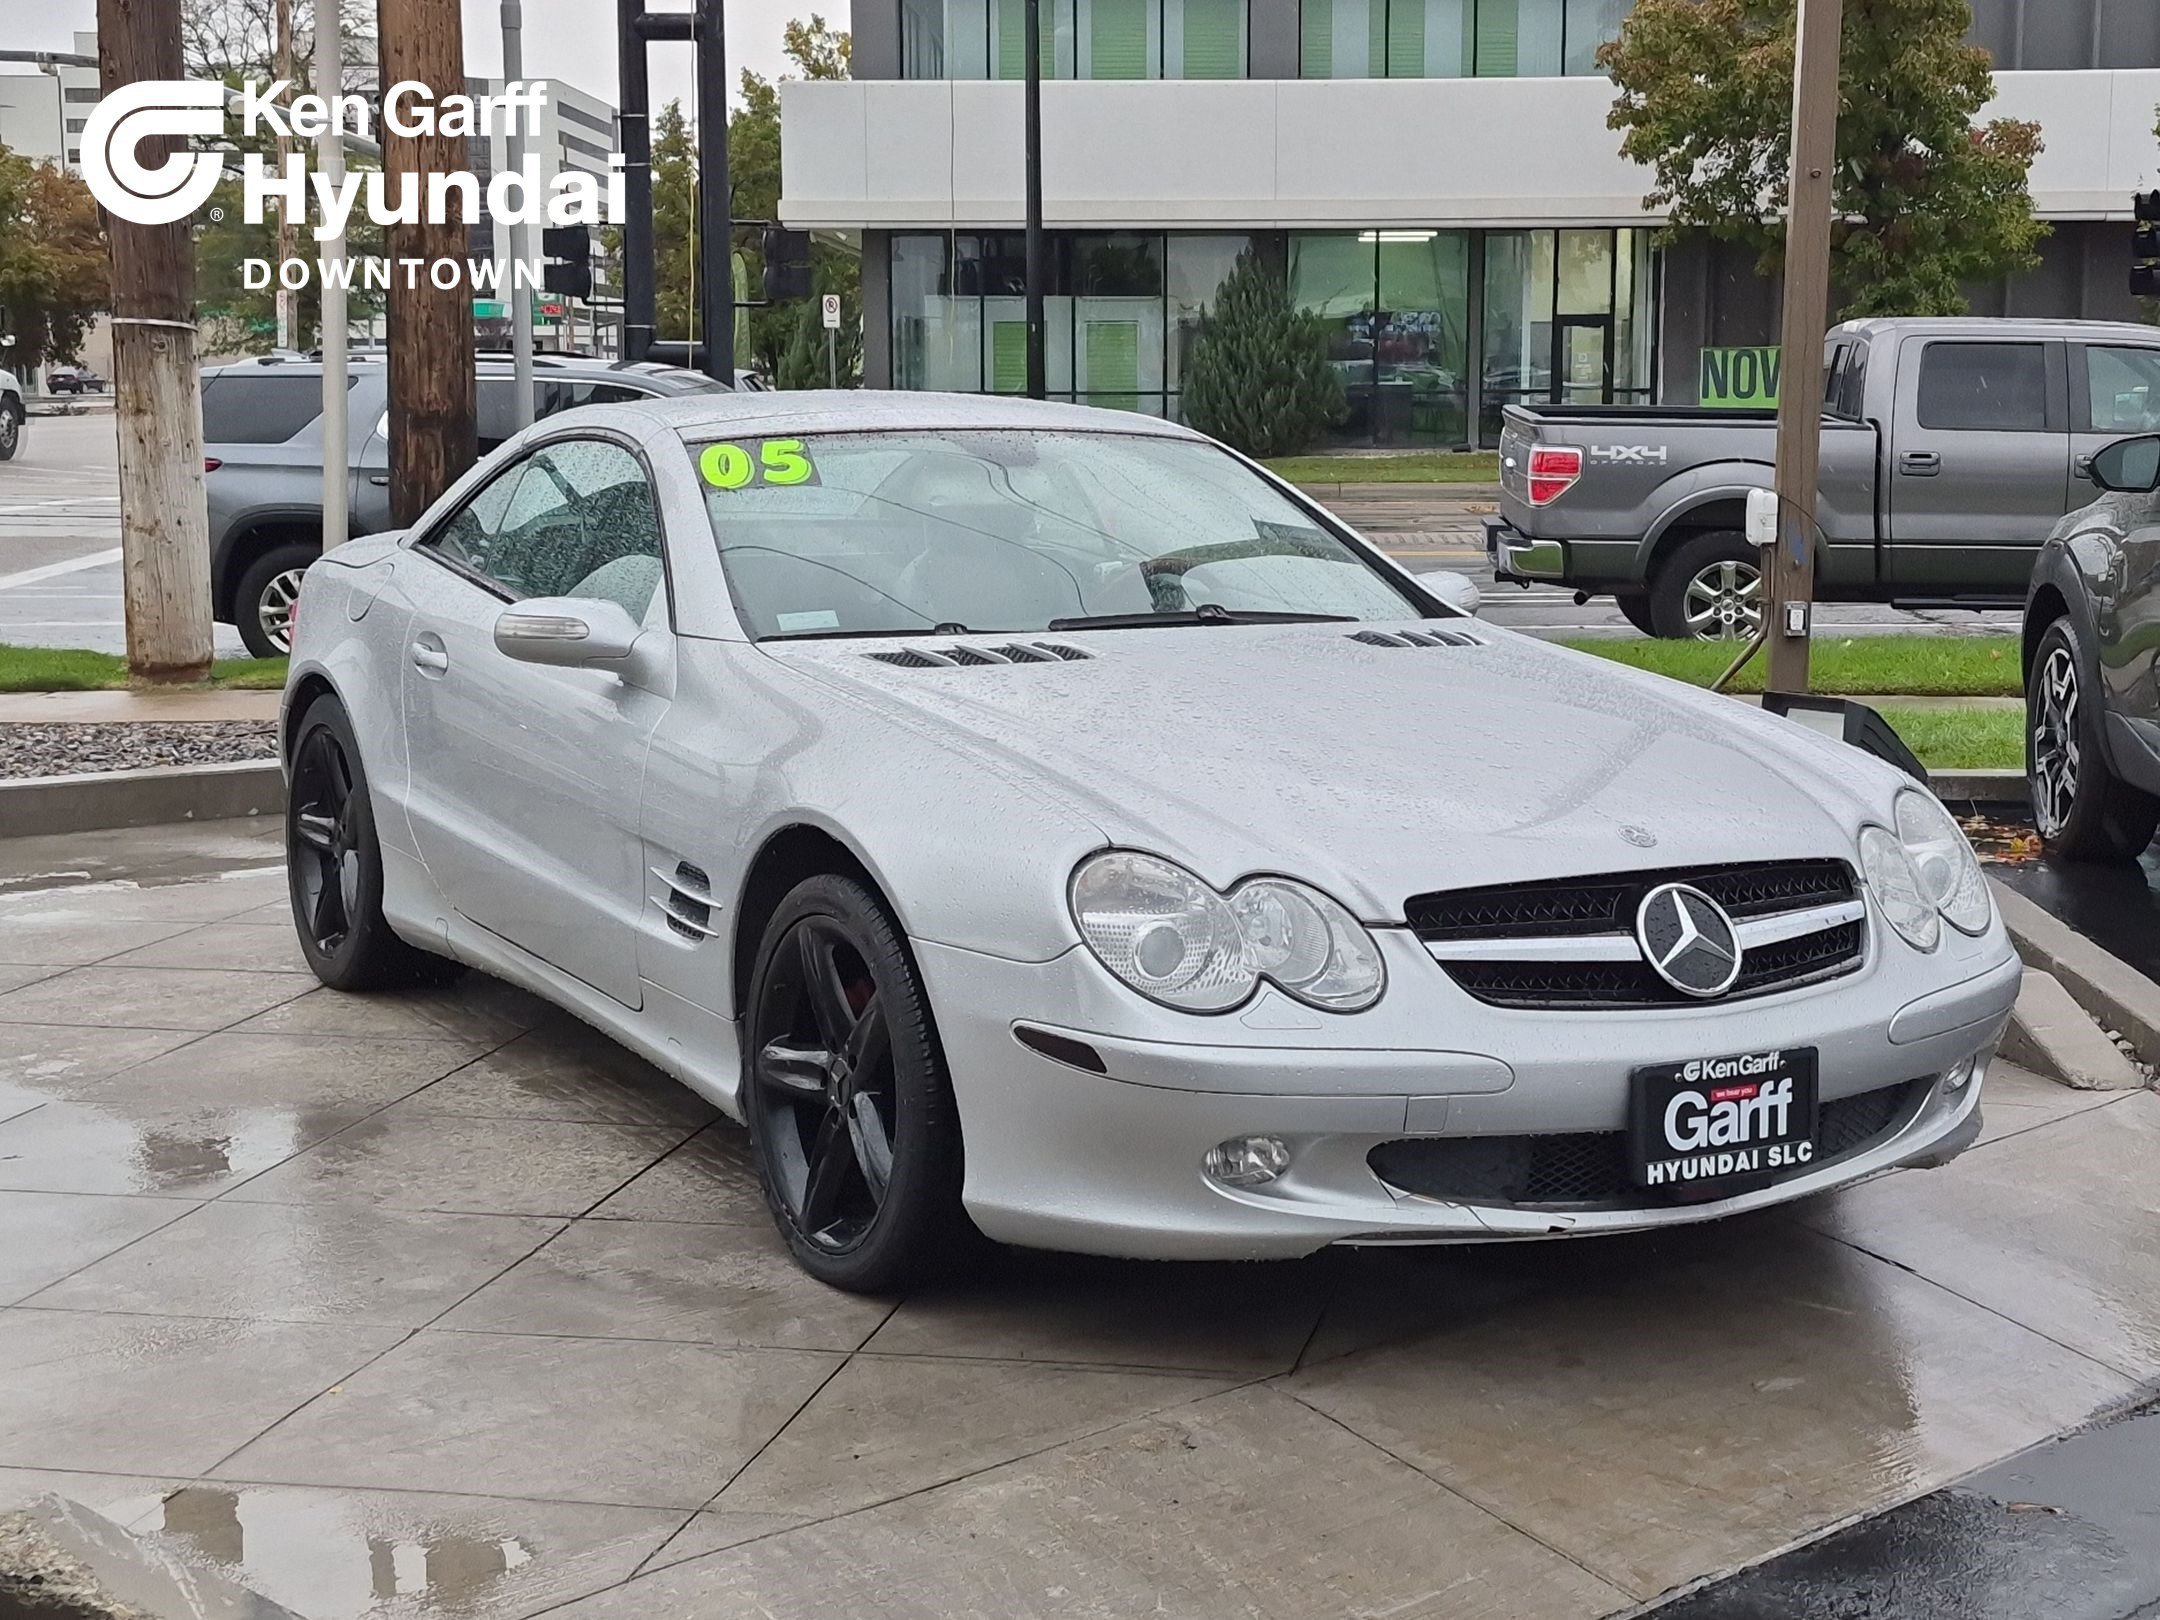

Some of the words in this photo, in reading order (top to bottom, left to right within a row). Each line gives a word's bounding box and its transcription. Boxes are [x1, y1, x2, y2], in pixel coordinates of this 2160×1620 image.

[700, 440, 812, 489] 05
[1702, 1059, 1738, 1081] Ken
[1739, 1051, 1780, 1076] Garff
[1664, 1077, 1793, 1151] Garff
[1647, 1149, 1759, 1185] HYUNDAI
[1768, 1141, 1813, 1167] SLC
